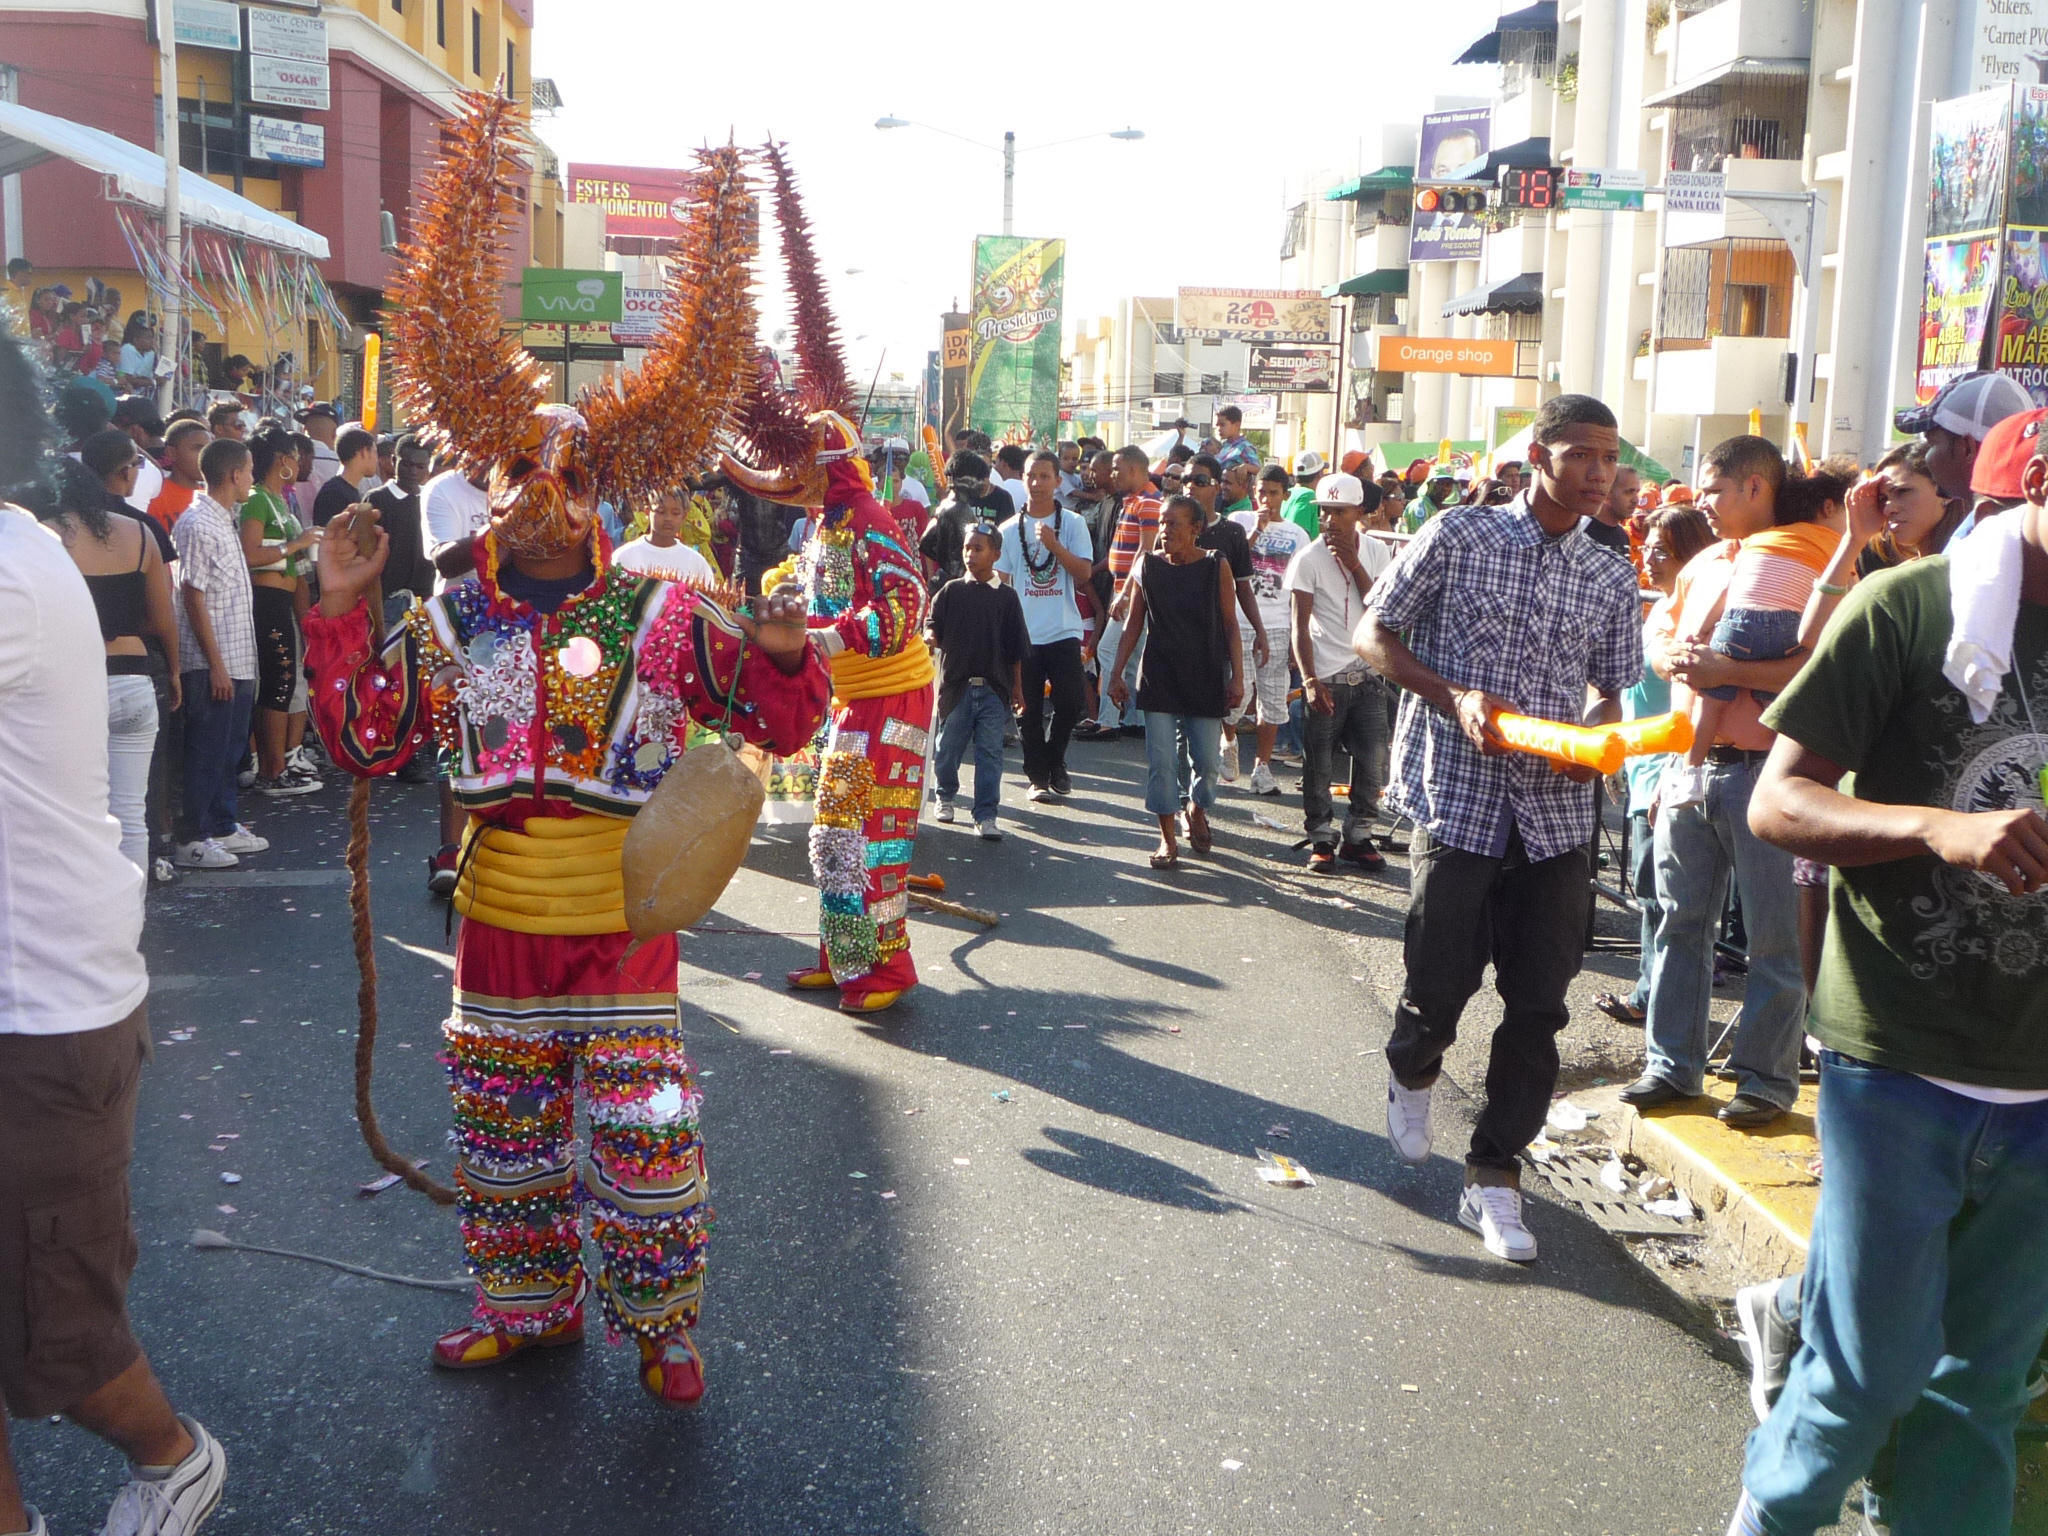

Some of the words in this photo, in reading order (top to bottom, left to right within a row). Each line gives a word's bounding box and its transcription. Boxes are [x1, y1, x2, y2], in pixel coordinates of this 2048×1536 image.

[576, 179, 609, 198] ESTE
[612, 181, 630, 199] ES
[1670, 189, 1721, 199] FARMACIA
[1667, 199, 1693, 209] SANTA
[1695, 200, 1721, 211] LUCIA
[626, 290, 663, 299] ENTRO
[979, 308, 1056, 340] Presidente
[1181, 329, 1220, 339] 809
[1226, 330, 1265, 340] 724
[1273, 330, 1325, 341] 9400
[1400, 345, 1453, 364] Orange
[1457, 347, 1493, 365] shop
